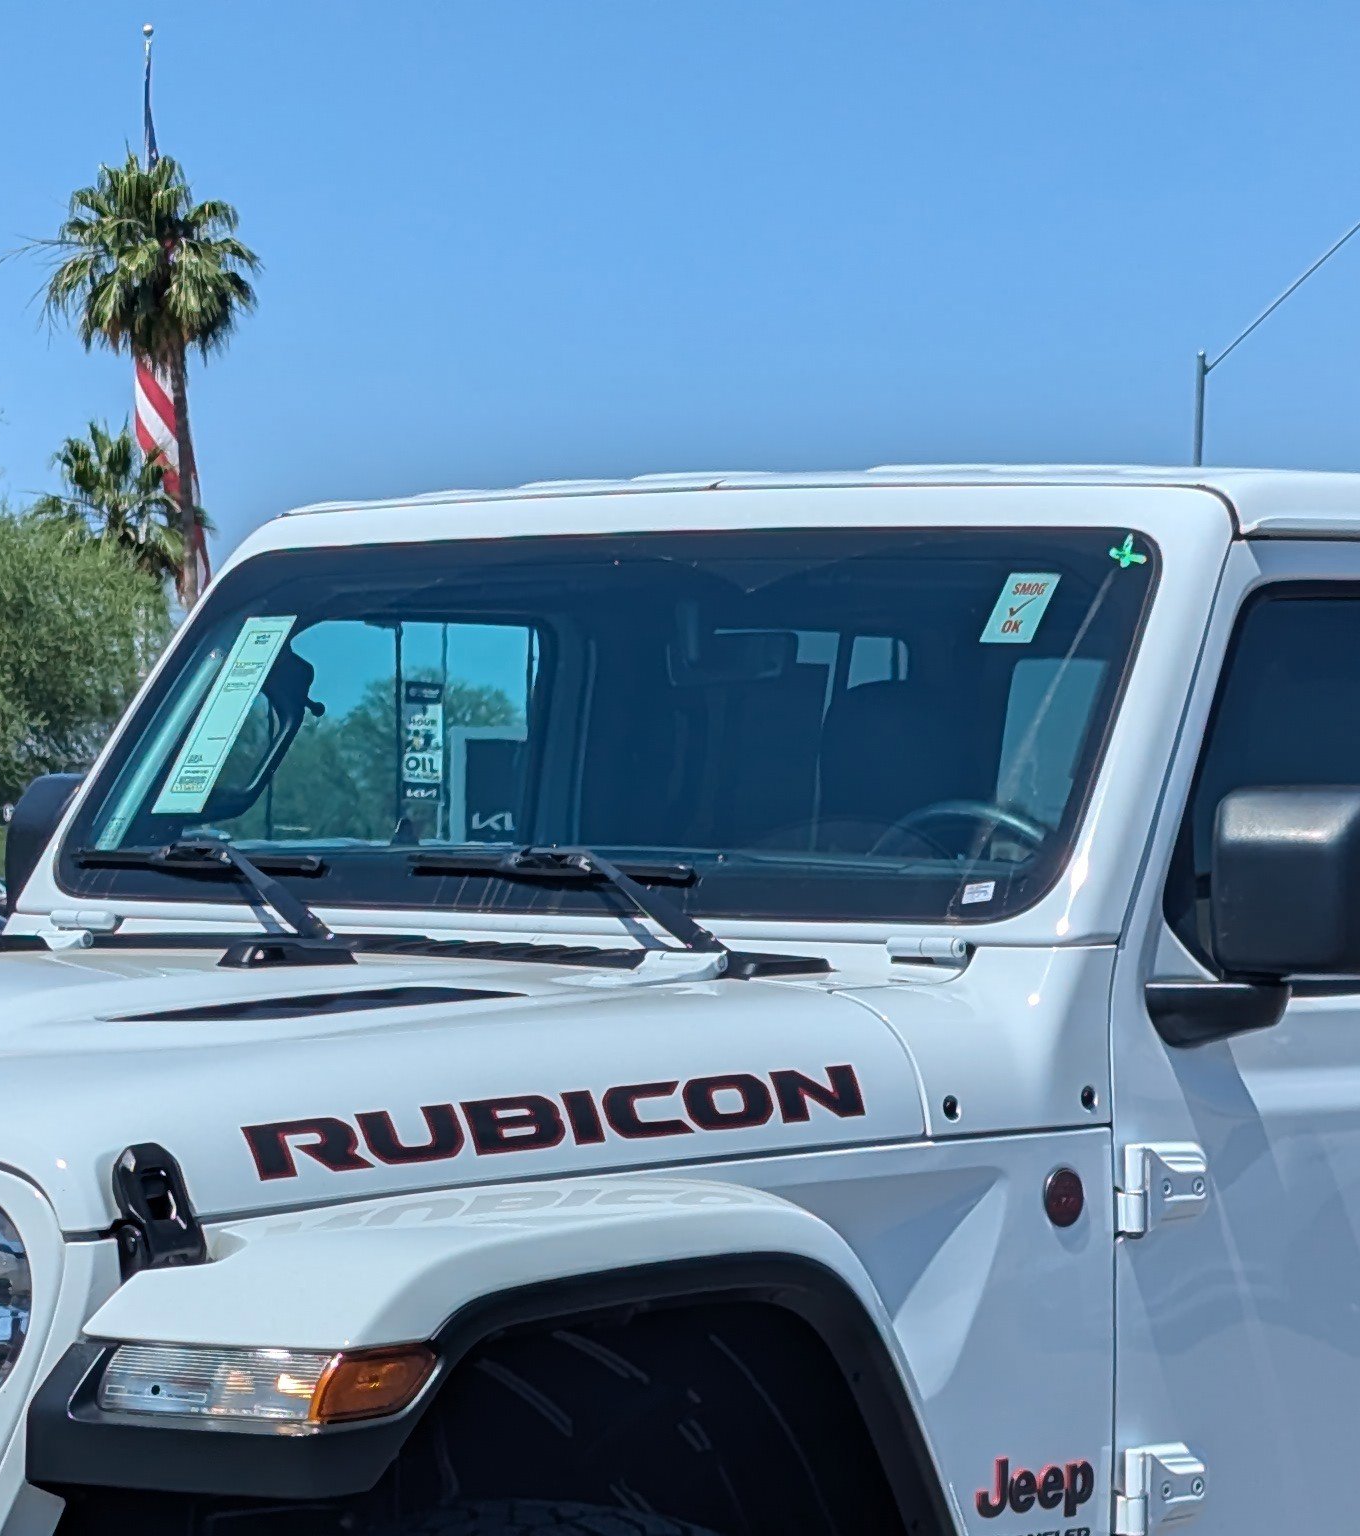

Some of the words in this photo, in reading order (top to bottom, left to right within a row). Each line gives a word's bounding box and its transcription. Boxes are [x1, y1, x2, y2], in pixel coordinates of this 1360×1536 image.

[1012, 582, 1050, 596] SMOG
[1001, 619, 1023, 634] OK
[405, 756, 439, 773] OIL
[240, 1064, 865, 1181] RUBICON
[974, 1455, 1095, 1518] Jeep
